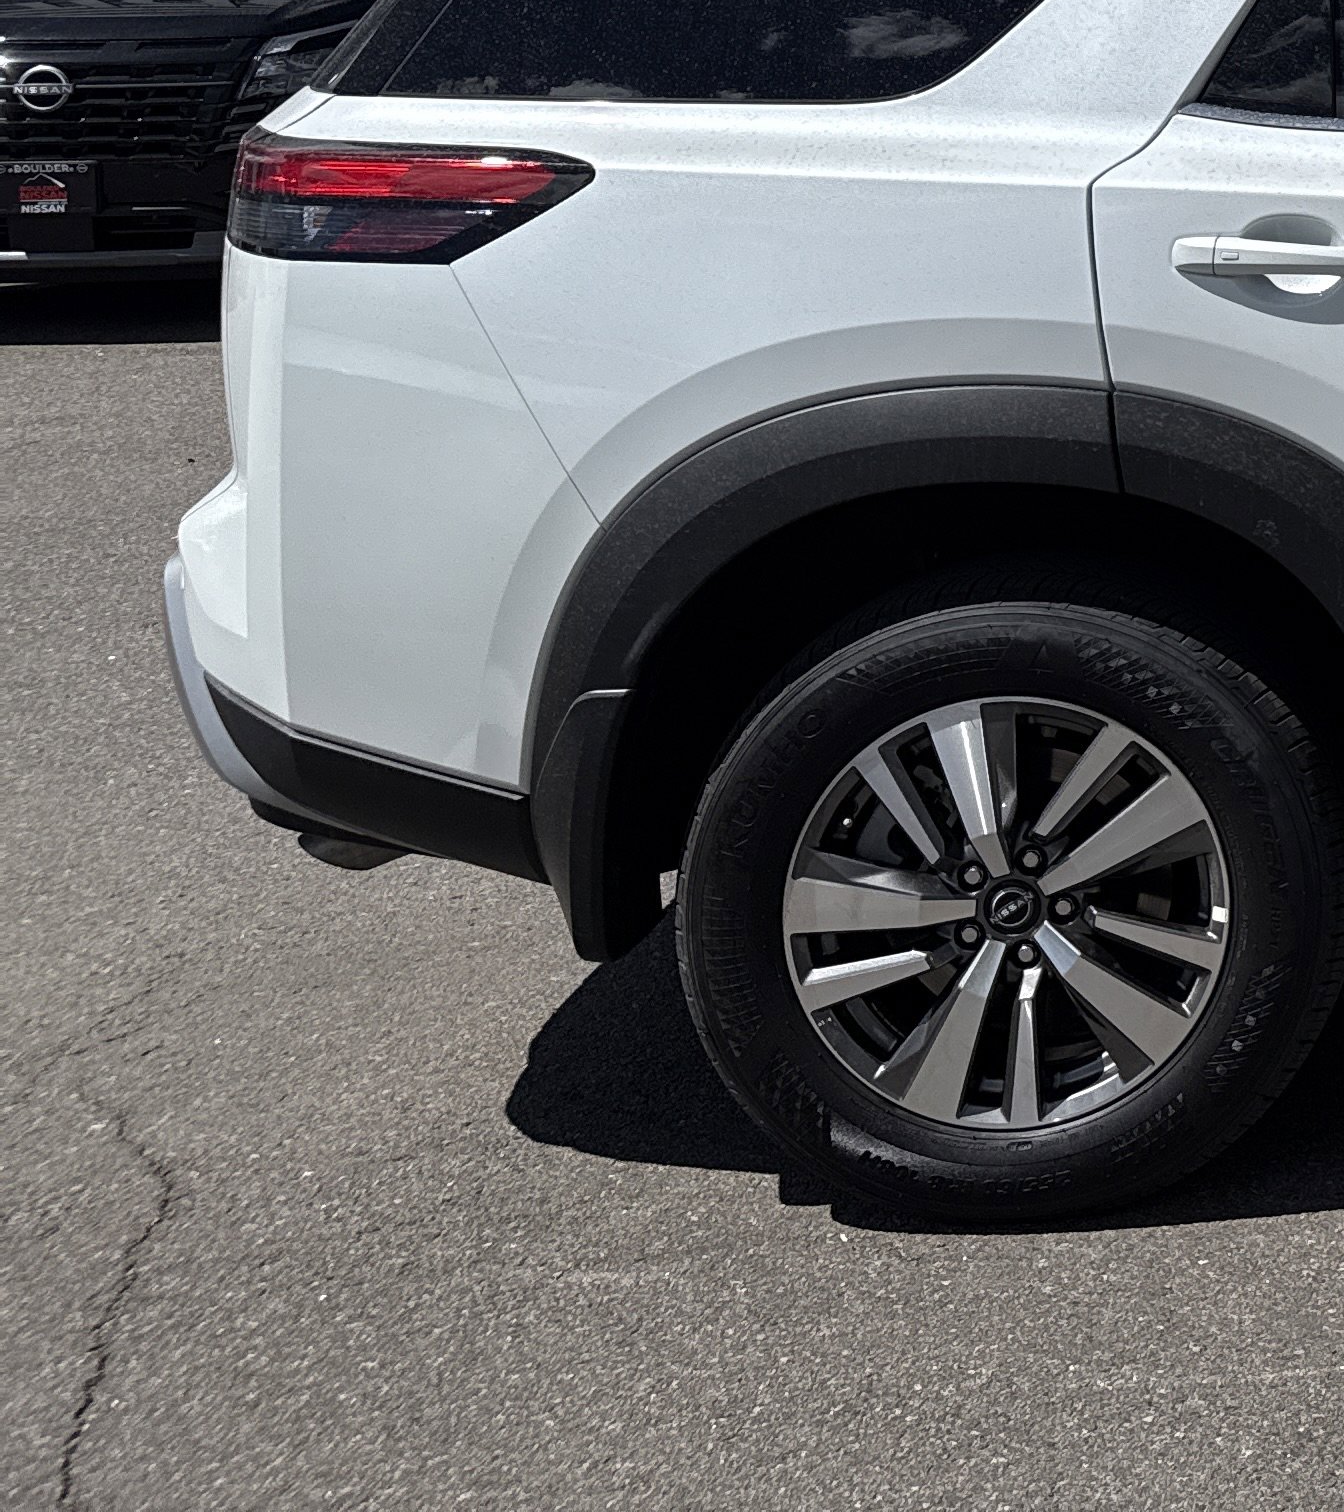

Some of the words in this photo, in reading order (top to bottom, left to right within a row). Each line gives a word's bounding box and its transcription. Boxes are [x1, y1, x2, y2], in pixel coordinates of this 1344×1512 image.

[13, 85, 73, 95] NISSAN
[13, 164, 71, 173] BOULDER
[20, 204, 66, 213] NISSAN
[989, 891, 1034, 925] NISSAN
